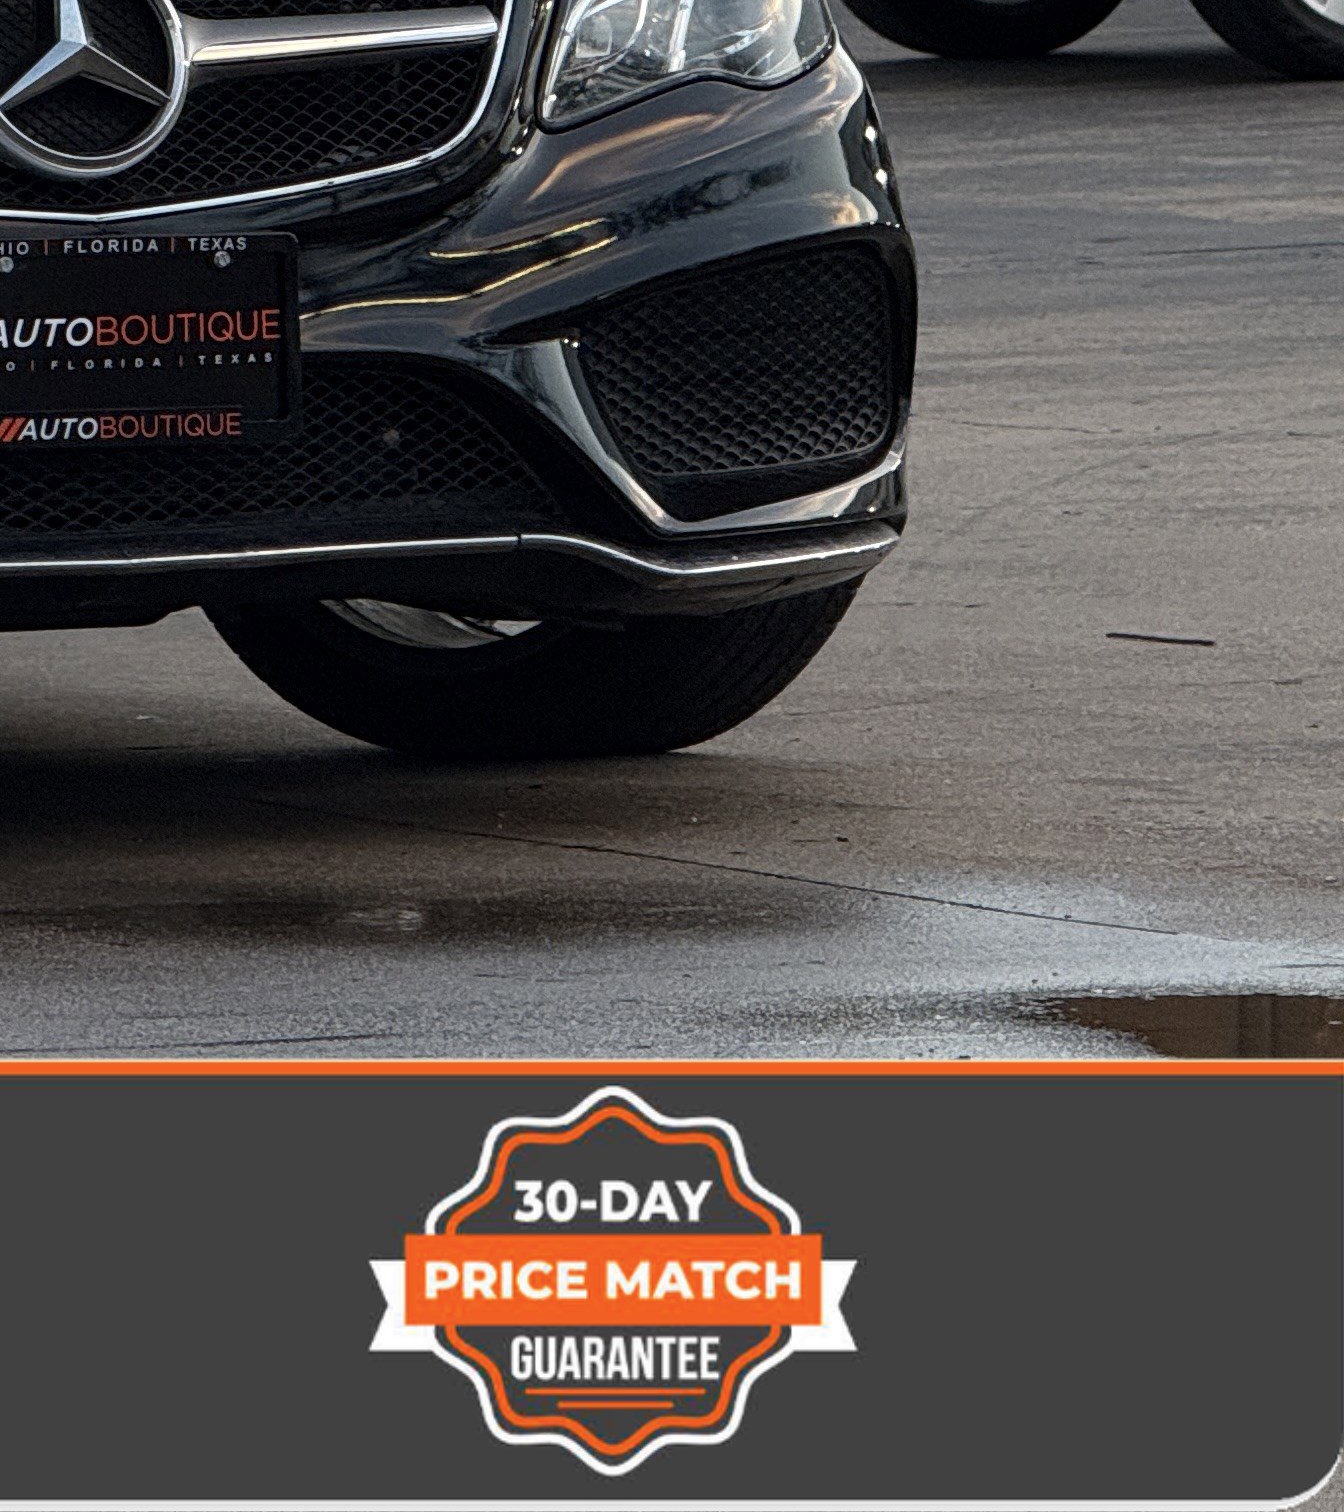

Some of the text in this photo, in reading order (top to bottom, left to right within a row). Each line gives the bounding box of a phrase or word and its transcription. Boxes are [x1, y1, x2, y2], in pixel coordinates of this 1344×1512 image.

[63, 237, 159, 254] FLORIDA
[188, 235, 247, 252] TEXAS
[50, 357, 162, 371] FLORIDA
[198, 351, 274, 366] TEXAS
